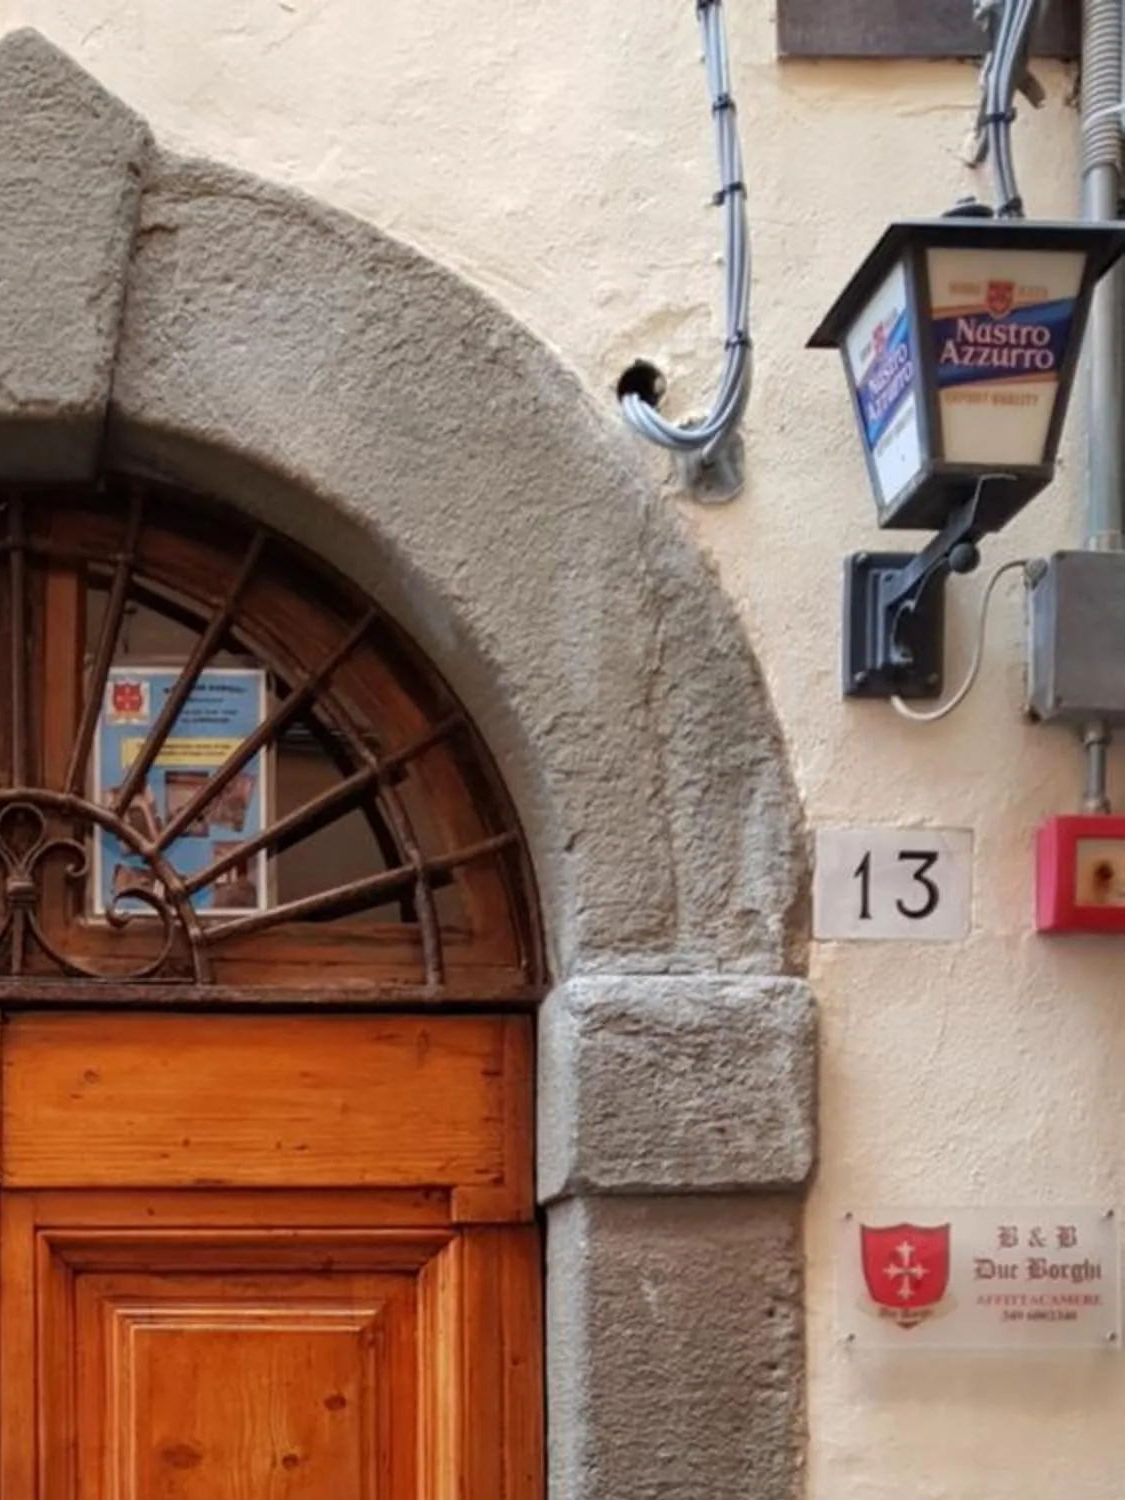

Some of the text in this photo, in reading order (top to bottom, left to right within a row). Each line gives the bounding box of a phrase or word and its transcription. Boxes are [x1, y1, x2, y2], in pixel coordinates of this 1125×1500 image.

[956, 318, 1051, 346] Nastro
[939, 340, 1055, 369] Azzurro
[853, 851, 939, 920] 13
[997, 1226, 1078, 1249] B & B
[973, 1257, 1102, 1284] Due Borghi
